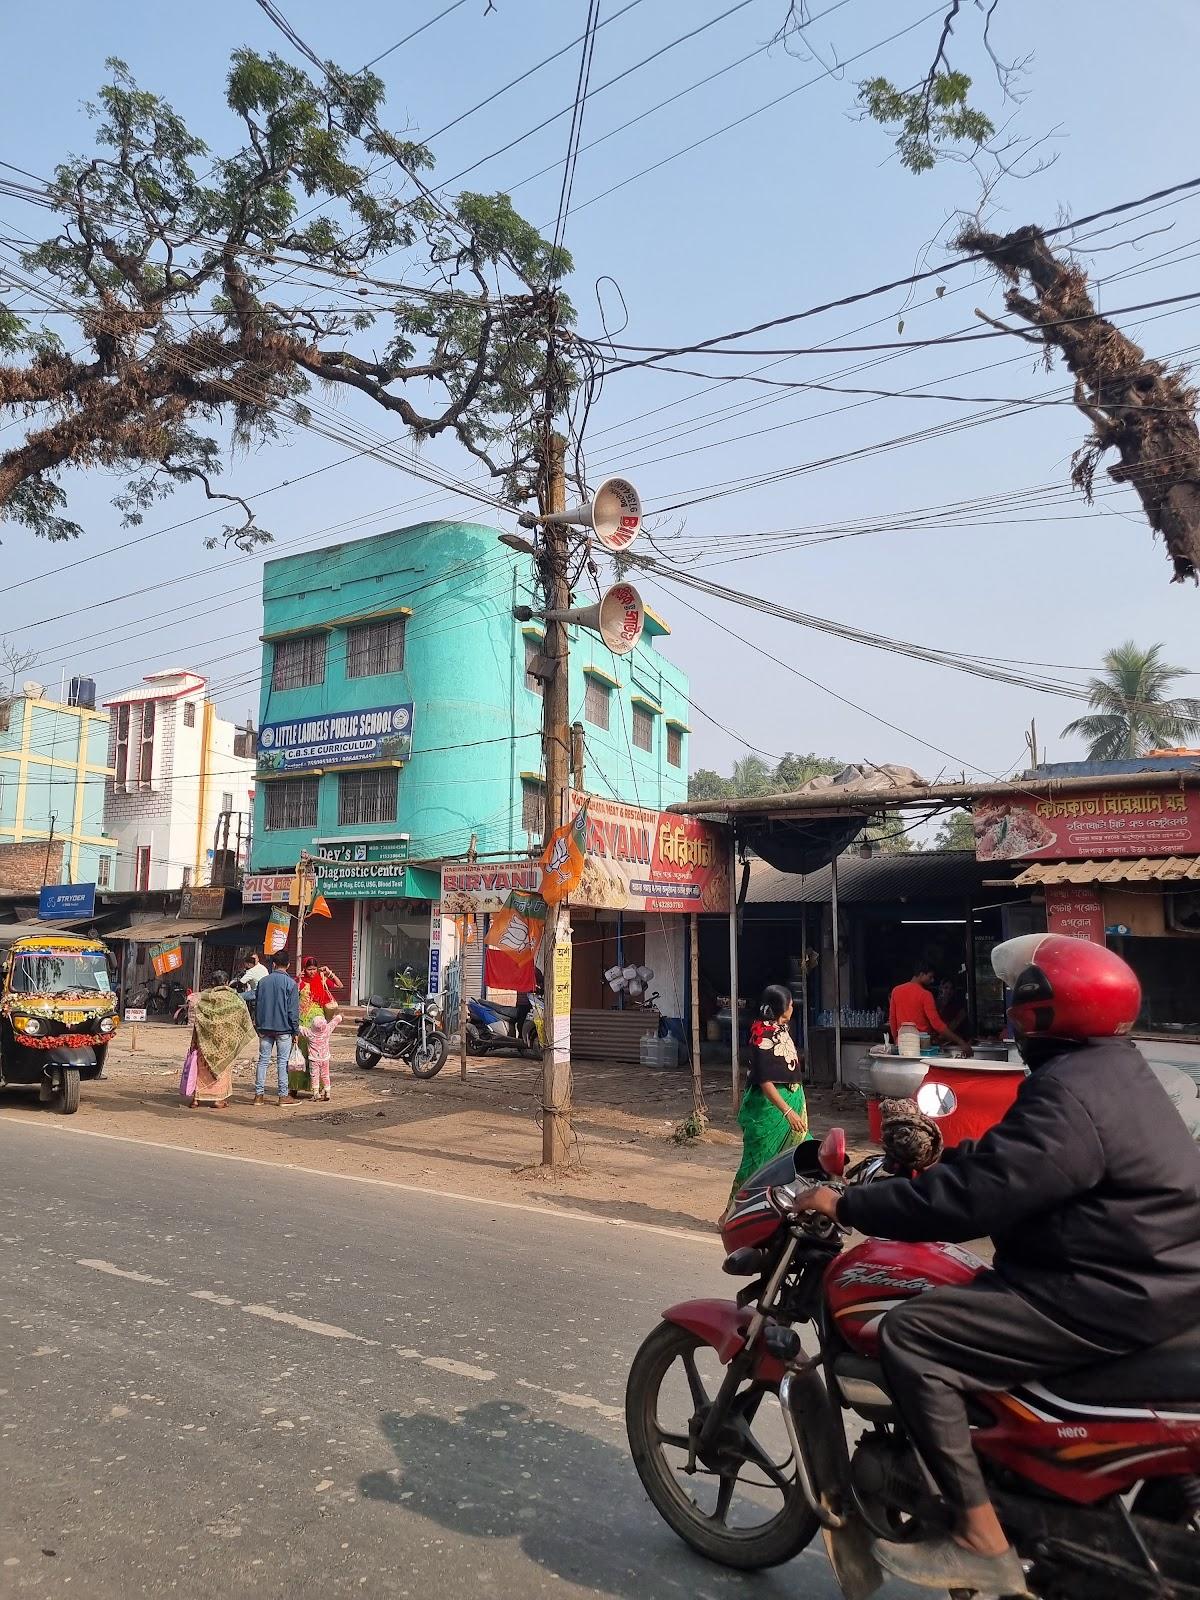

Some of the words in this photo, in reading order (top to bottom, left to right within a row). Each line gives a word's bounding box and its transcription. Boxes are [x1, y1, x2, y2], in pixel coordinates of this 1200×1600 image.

[275, 725, 298, 748] LITTLE
[298, 719, 330, 744] LAURELS
[330, 715, 358, 740] PUBLIC
[359, 710, 392, 736] SCHOOL
[317, 740, 373, 754] CURRICULUM
[319, 845, 351, 861] Dey's
[318, 864, 369, 881] Diagnostic
[370, 864, 405, 877] Centre
[443, 870, 538, 891] BIRYANI
[377, 880, 391, 888] Blood
[392, 880, 403, 888] Test
[1057, 1426, 1088, 1438] Hero
